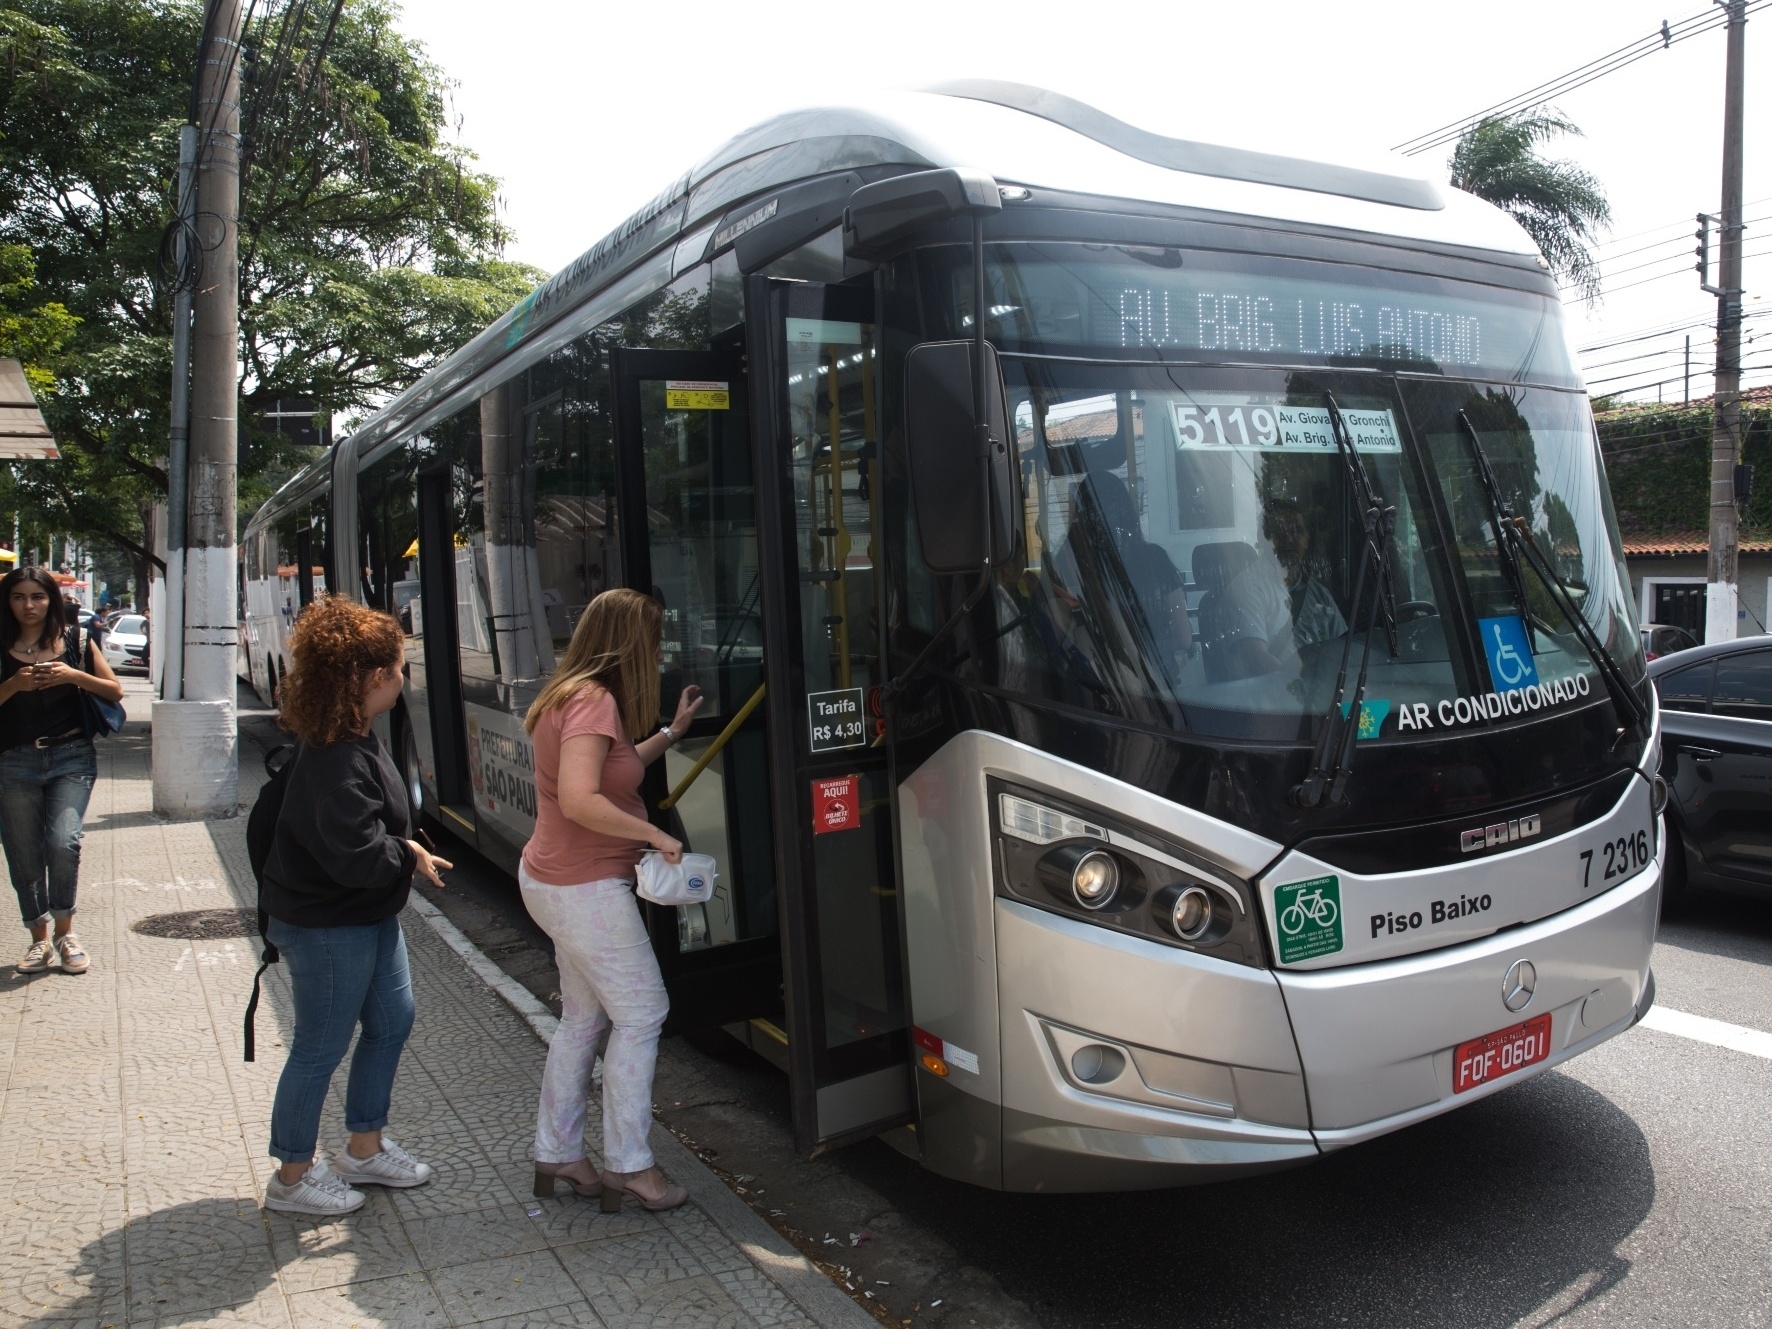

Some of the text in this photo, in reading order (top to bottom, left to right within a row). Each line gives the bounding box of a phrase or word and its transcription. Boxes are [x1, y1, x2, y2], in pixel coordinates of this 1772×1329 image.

[1120, 289, 1178, 347] AV.
[1198, 293, 1281, 351] BRIG.
[1298, 299, 1364, 356] LUIS
[1177, 406, 1278, 447] 5119
[1280, 411, 1391, 427] Av. Giovai Gronchi
[1285, 431, 1302, 444] Av.
[1304, 431, 1330, 446] Brig.
[1357, 433, 1396, 446] Antonio
[816, 699, 856, 716] Tarifa
[1398, 672, 1590, 730] AR CONDICIONADO
[481, 728, 532, 773] PREFEITURA
[813, 721, 862, 741] R$ 4,30
[485, 758, 508, 804] SÃO
[820, 780, 851, 789] RECARREGUE
[823, 785, 849, 798] AQUI!
[825, 810, 849, 820] BILHETE
[1461, 813, 1541, 853] CAIO
[1580, 829, 1649, 888] 7 2316
[1370, 894, 1492, 939] Piso Baixo
